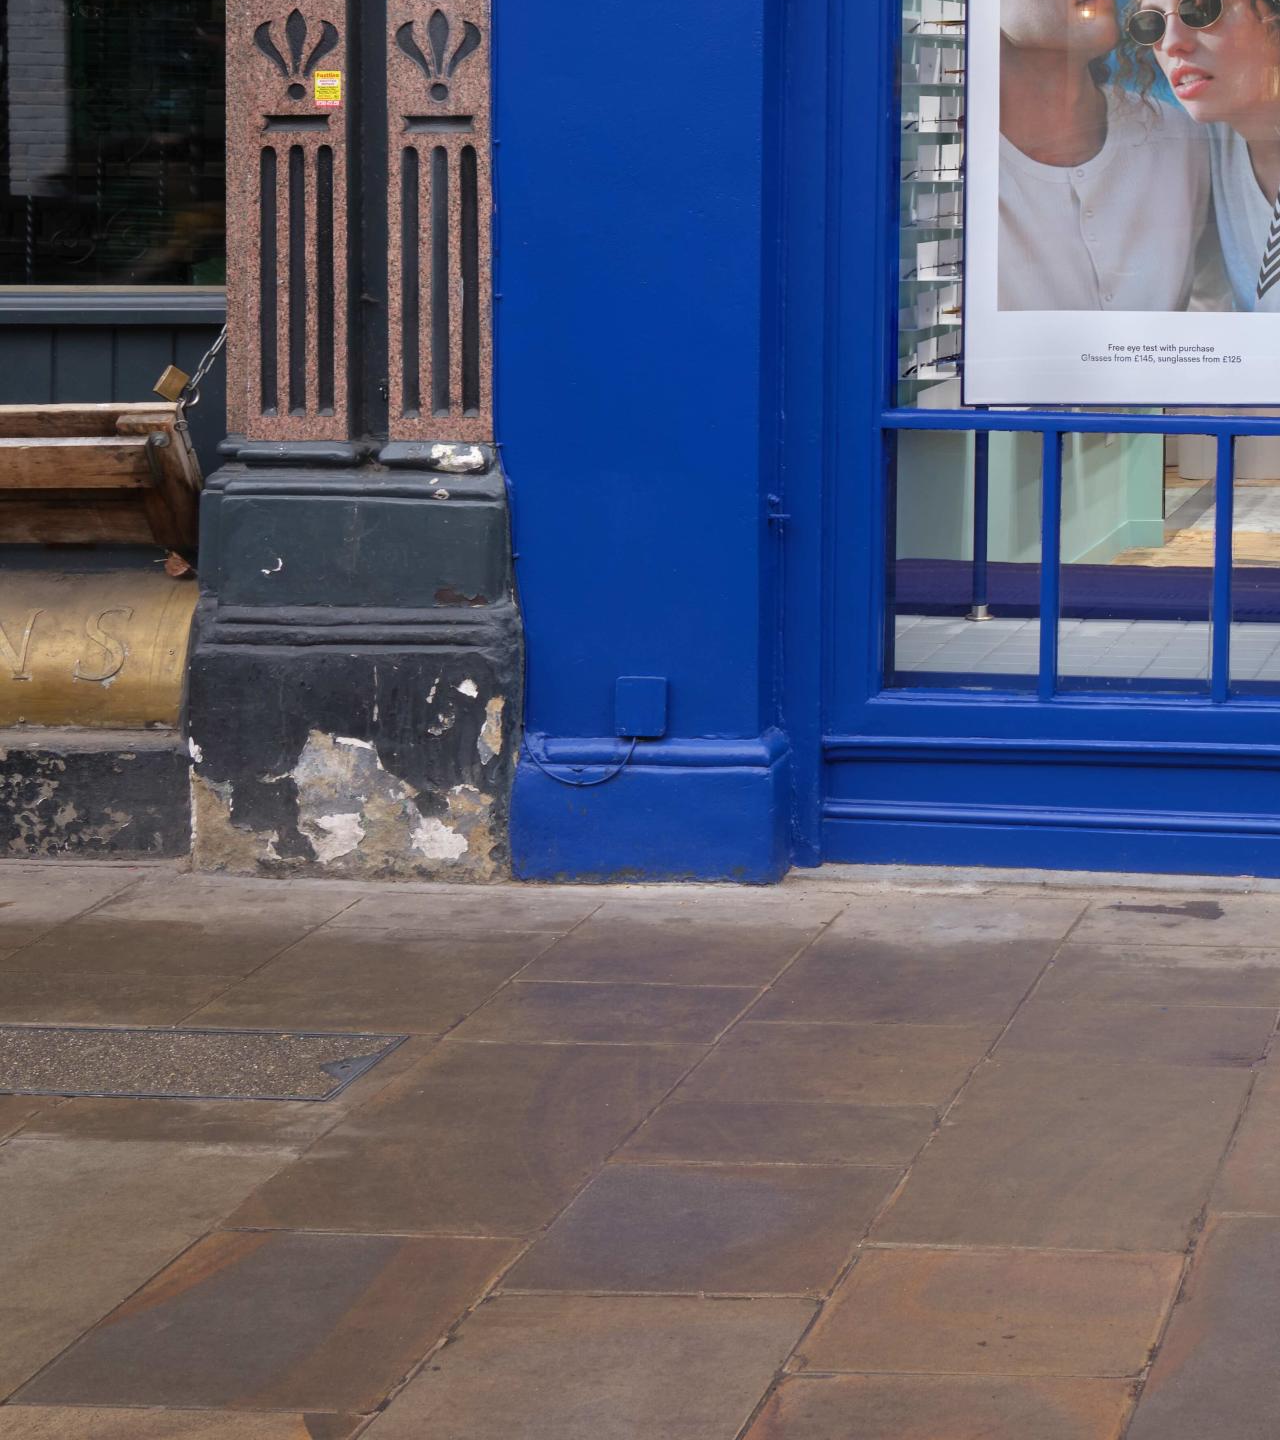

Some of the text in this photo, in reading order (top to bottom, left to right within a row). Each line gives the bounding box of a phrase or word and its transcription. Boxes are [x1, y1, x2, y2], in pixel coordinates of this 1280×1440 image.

[1108, 344, 1215, 354] Free eye test with purchase
[1081, 354, 1112, 362] Glasses
[1114, 354, 1132, 362] from
[1134, 355, 1155, 363] £145,
[1158, 355, 1200, 364] sunglasses
[1202, 355, 1220, 363] from
